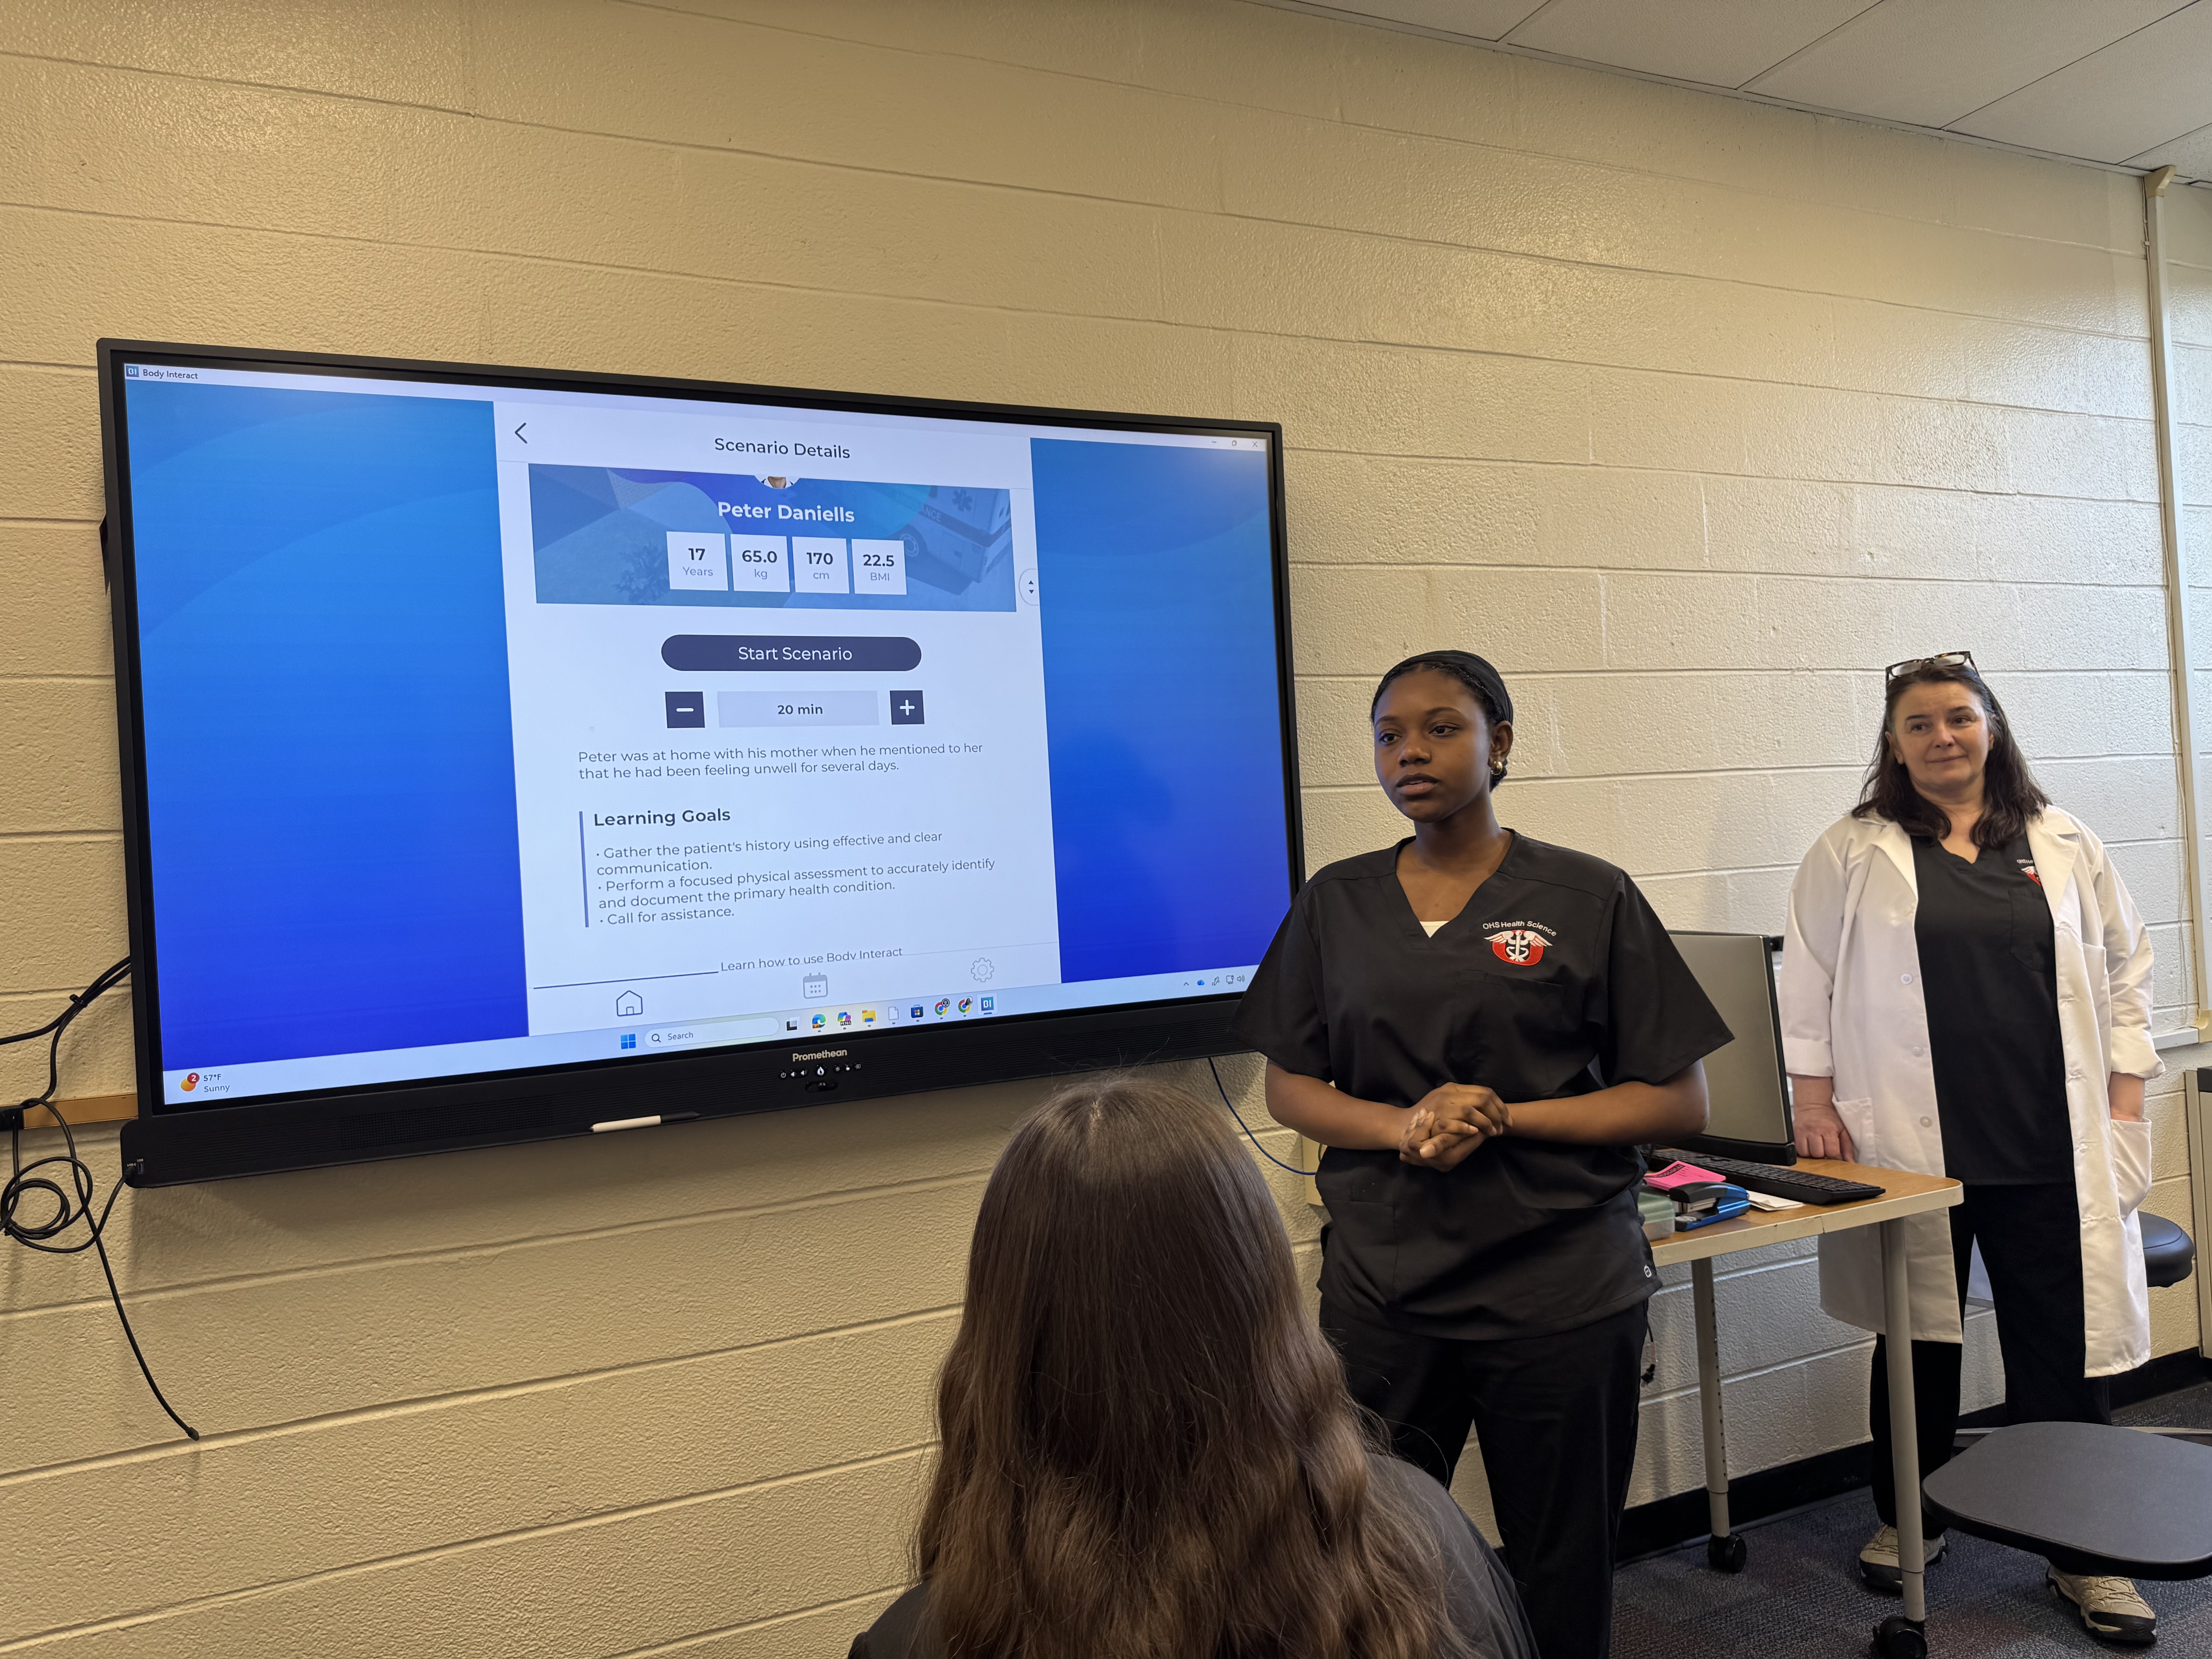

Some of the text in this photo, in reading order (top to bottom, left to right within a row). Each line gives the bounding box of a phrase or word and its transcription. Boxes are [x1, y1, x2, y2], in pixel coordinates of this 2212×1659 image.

[143, 369, 198, 379] Body Interact
[714, 438, 850, 459] Scenario Details
[718, 501, 855, 522] Peter Daniells
[688, 548, 706, 561] 17
[742, 550, 778, 563] 65.0
[806, 552, 833, 565] 170
[862, 554, 895, 567] 22.5
[682, 567, 713, 577] Years
[754, 568, 768, 580] kg
[870, 572, 890, 582] BMI
[738, 646, 852, 660] Start Scenario
[777, 703, 823, 715] 20 min
[579, 743, 983, 763] Peter was at home with his mother when he mentioned to her
[578, 760, 899, 779] that he had been feeling unwell for several days.
[594, 808, 731, 826] Learning Goals
[604, 832, 942, 859] Gather the patient's history using effective and clear
[597, 859, 712, 876] communication.
[606, 858, 995, 892] Perform a focused physical assessment to accurately identify
[599, 880, 895, 909] and document the primary health condition.
[607, 908, 734, 925] Call for assistance.
[1527, 921, 1557, 936] Science
[721, 961, 755, 972] Learn
[759, 958, 785, 968] how
[788, 957, 800, 965] to
[804, 956, 824, 964] use
[859, 948, 903, 958] Interact
[983, 1000, 991, 1008] BI
[667, 1031, 694, 1041] Search
[792, 1049, 848, 1062] Promethean
[203, 1073, 222, 1082] 57°F
